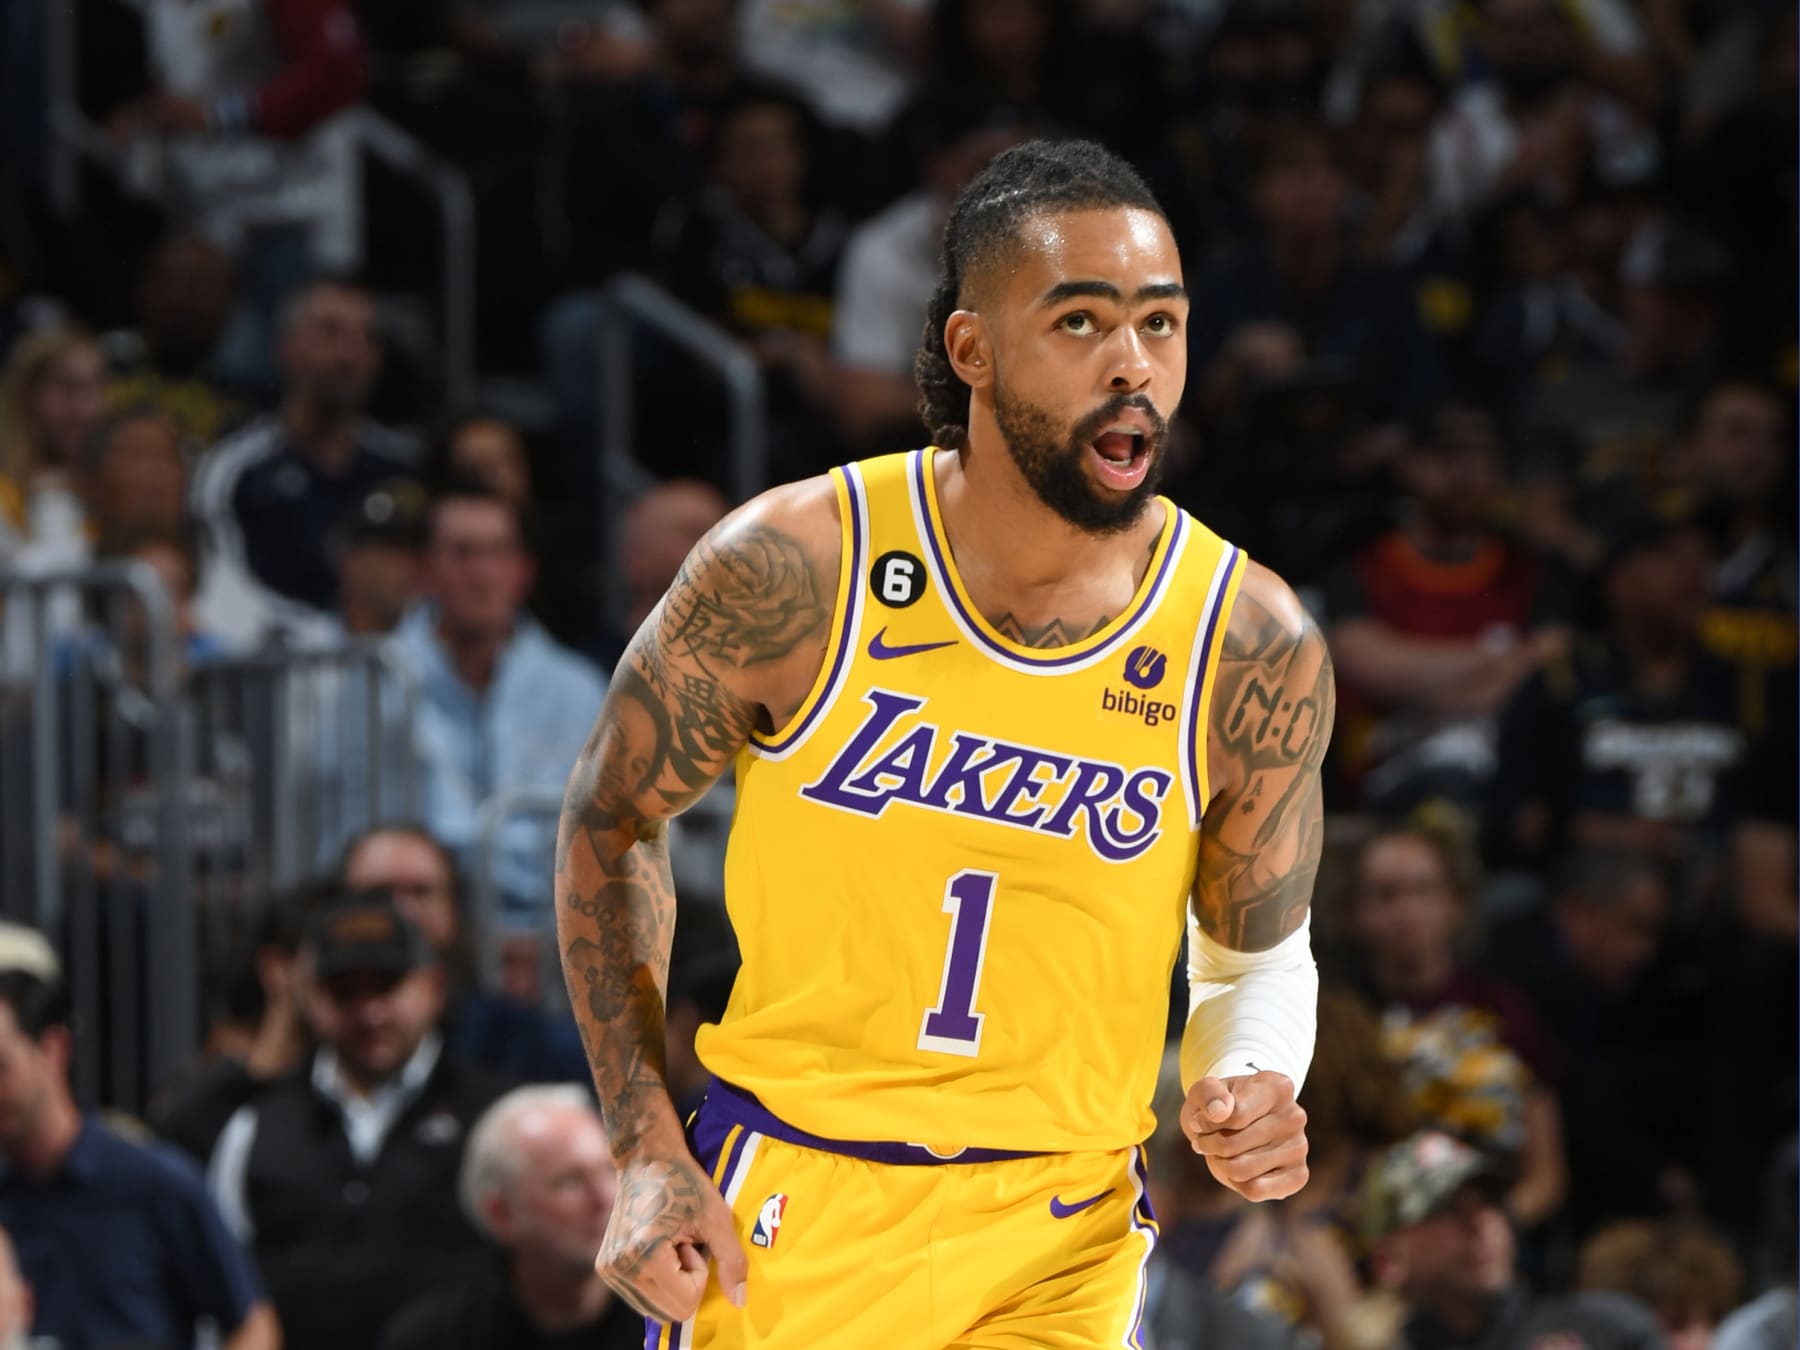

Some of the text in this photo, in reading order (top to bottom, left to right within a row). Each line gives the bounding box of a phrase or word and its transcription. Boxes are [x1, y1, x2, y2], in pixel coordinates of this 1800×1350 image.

[882, 557, 916, 603] 6
[1102, 687, 1176, 726] bibigo
[798, 685, 1174, 864] LAKERS
[916, 868, 999, 1057] 1
